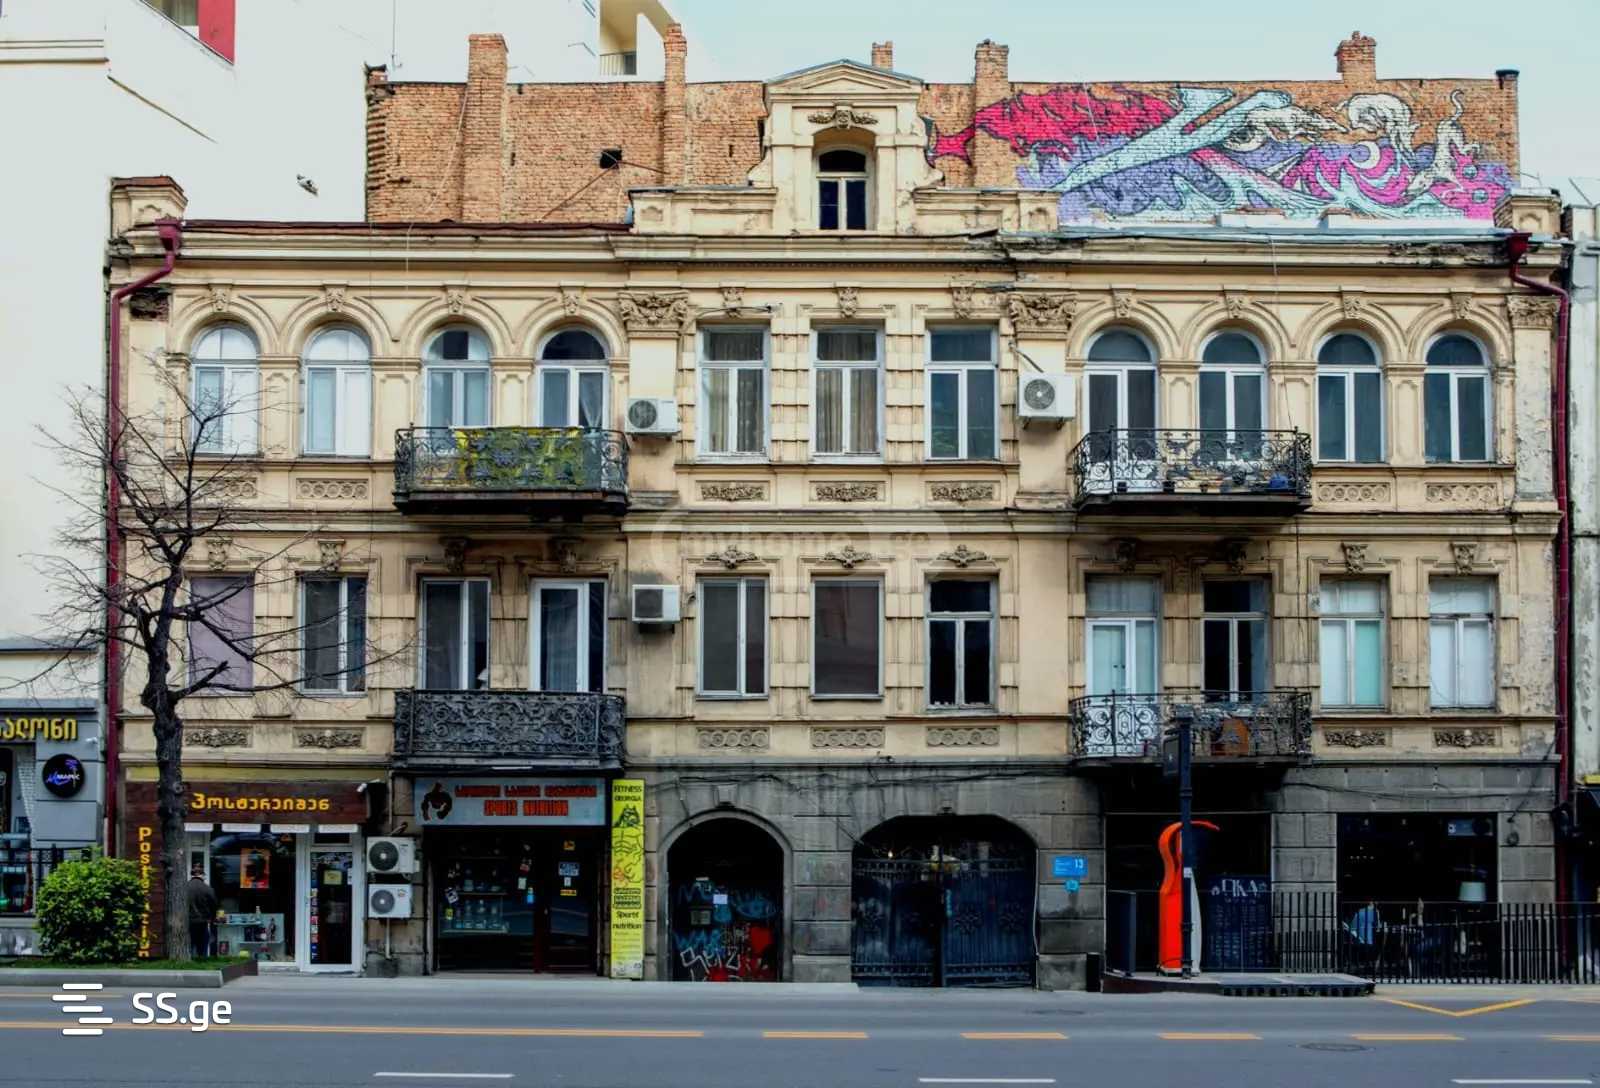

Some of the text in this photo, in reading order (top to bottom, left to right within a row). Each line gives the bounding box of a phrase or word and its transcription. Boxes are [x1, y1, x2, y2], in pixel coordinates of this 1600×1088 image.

[0, 717, 77, 740] ალონი
[191, 792, 330, 811] პოსტერეიშენ
[1074, 858, 1084, 869] 13
